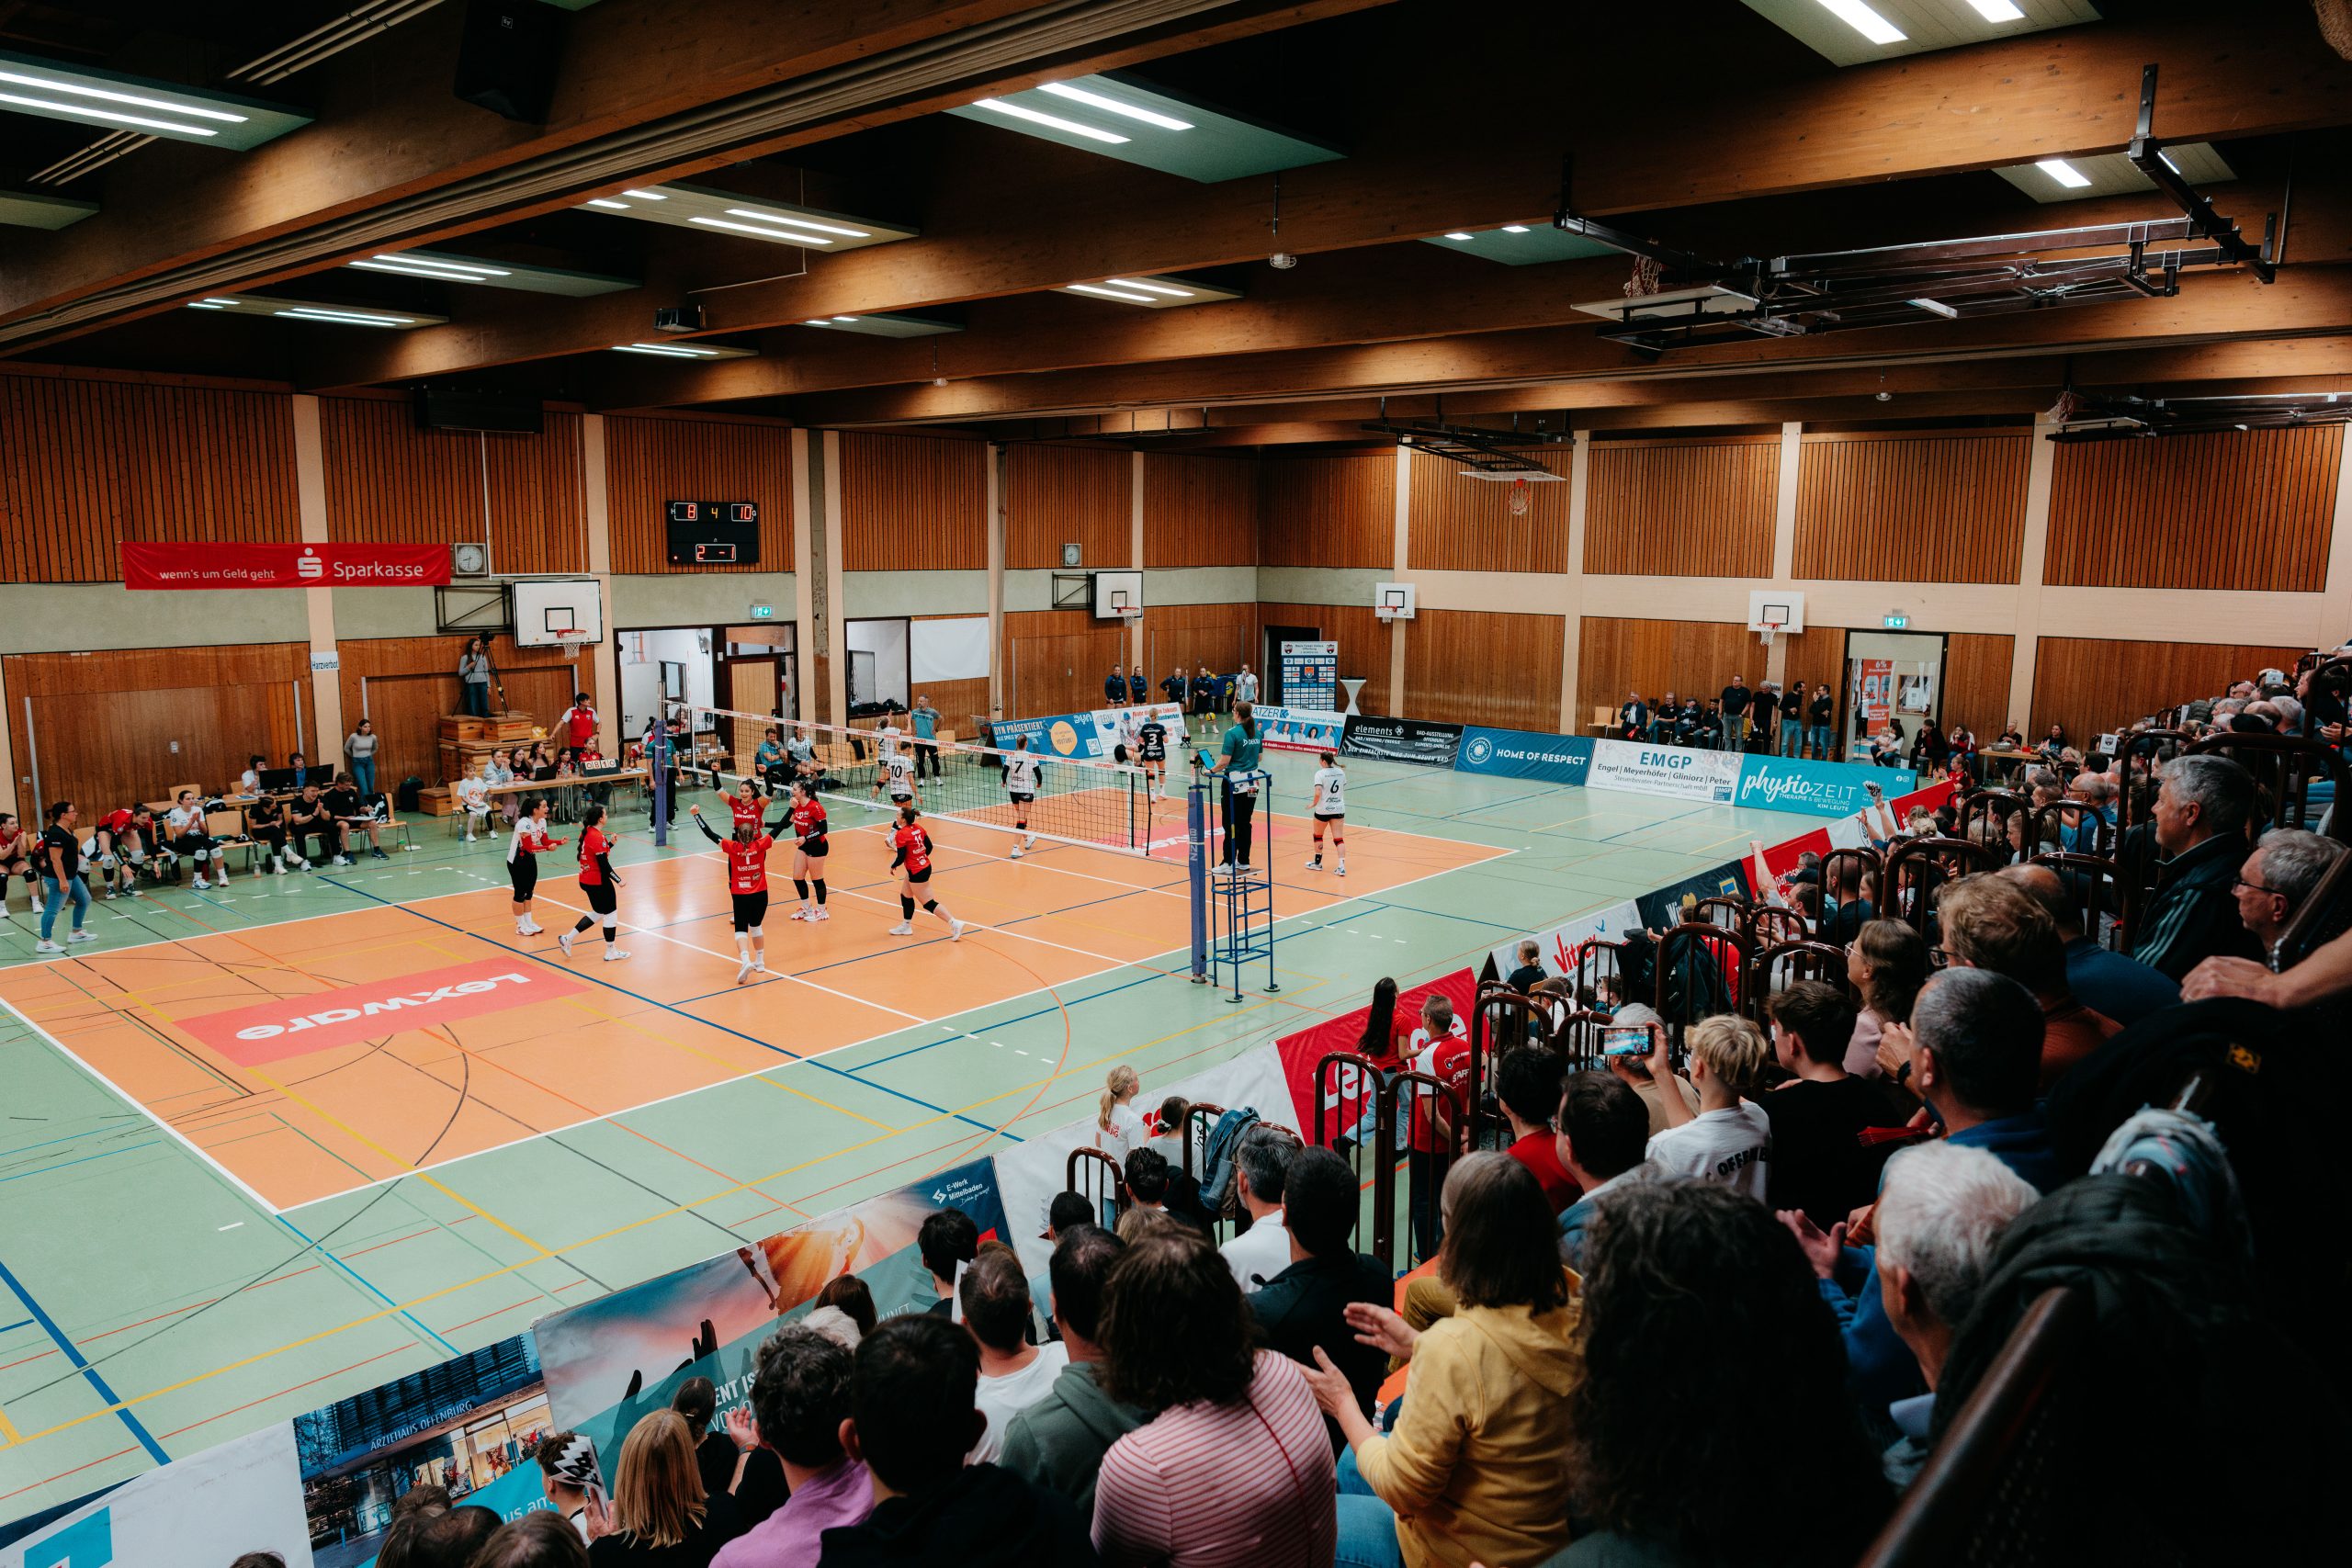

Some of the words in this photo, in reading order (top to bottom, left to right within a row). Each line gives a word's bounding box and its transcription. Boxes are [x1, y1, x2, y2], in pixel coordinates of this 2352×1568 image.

[687, 504, 695, 519] 8
[711, 507, 718, 519] 4
[741, 506, 752, 520] 10
[160, 570, 199, 580] wenn's
[202, 570, 220, 579] um
[223, 568, 248, 579] Geld
[251, 569, 276, 581] geht
[334, 561, 424, 581] Sparkasse
[311, 660, 338, 671] Harzverbot
[1252, 707, 1280, 718] ATZER
[1355, 724, 1393, 736] elements
[1148, 733, 1158, 746] 3
[1496, 749, 1524, 760] HOME
[1526, 751, 1541, 761] OF
[1542, 753, 1587, 765] RESPECT
[1640, 751, 1692, 770] EMGP
[890, 765, 902, 778] 10
[1014, 761, 1024, 773] 7
[1598, 763, 1619, 773] Engel
[1623, 766, 1668, 779] Meyerhöfer
[1672, 772, 1704, 783] Gliniorz
[1709, 776, 1732, 786] Peter
[1330, 780, 1339, 794] 6
[1779, 793, 1807, 802] THERAPIE
[1814, 796, 1850, 806] BEWEGUNG
[1829, 804, 1849, 812] LEUTE
[1189, 828, 1198, 862] BENZ
[235, 972, 533, 1041] Lexware
[945, 1179, 969, 1192] E-Werk
[948, 1183, 983, 1201] Mittelbaden
[370, 1423, 418, 1451] ÄRZTEHAUS
[420, 1401, 472, 1431] OFFENBURG
